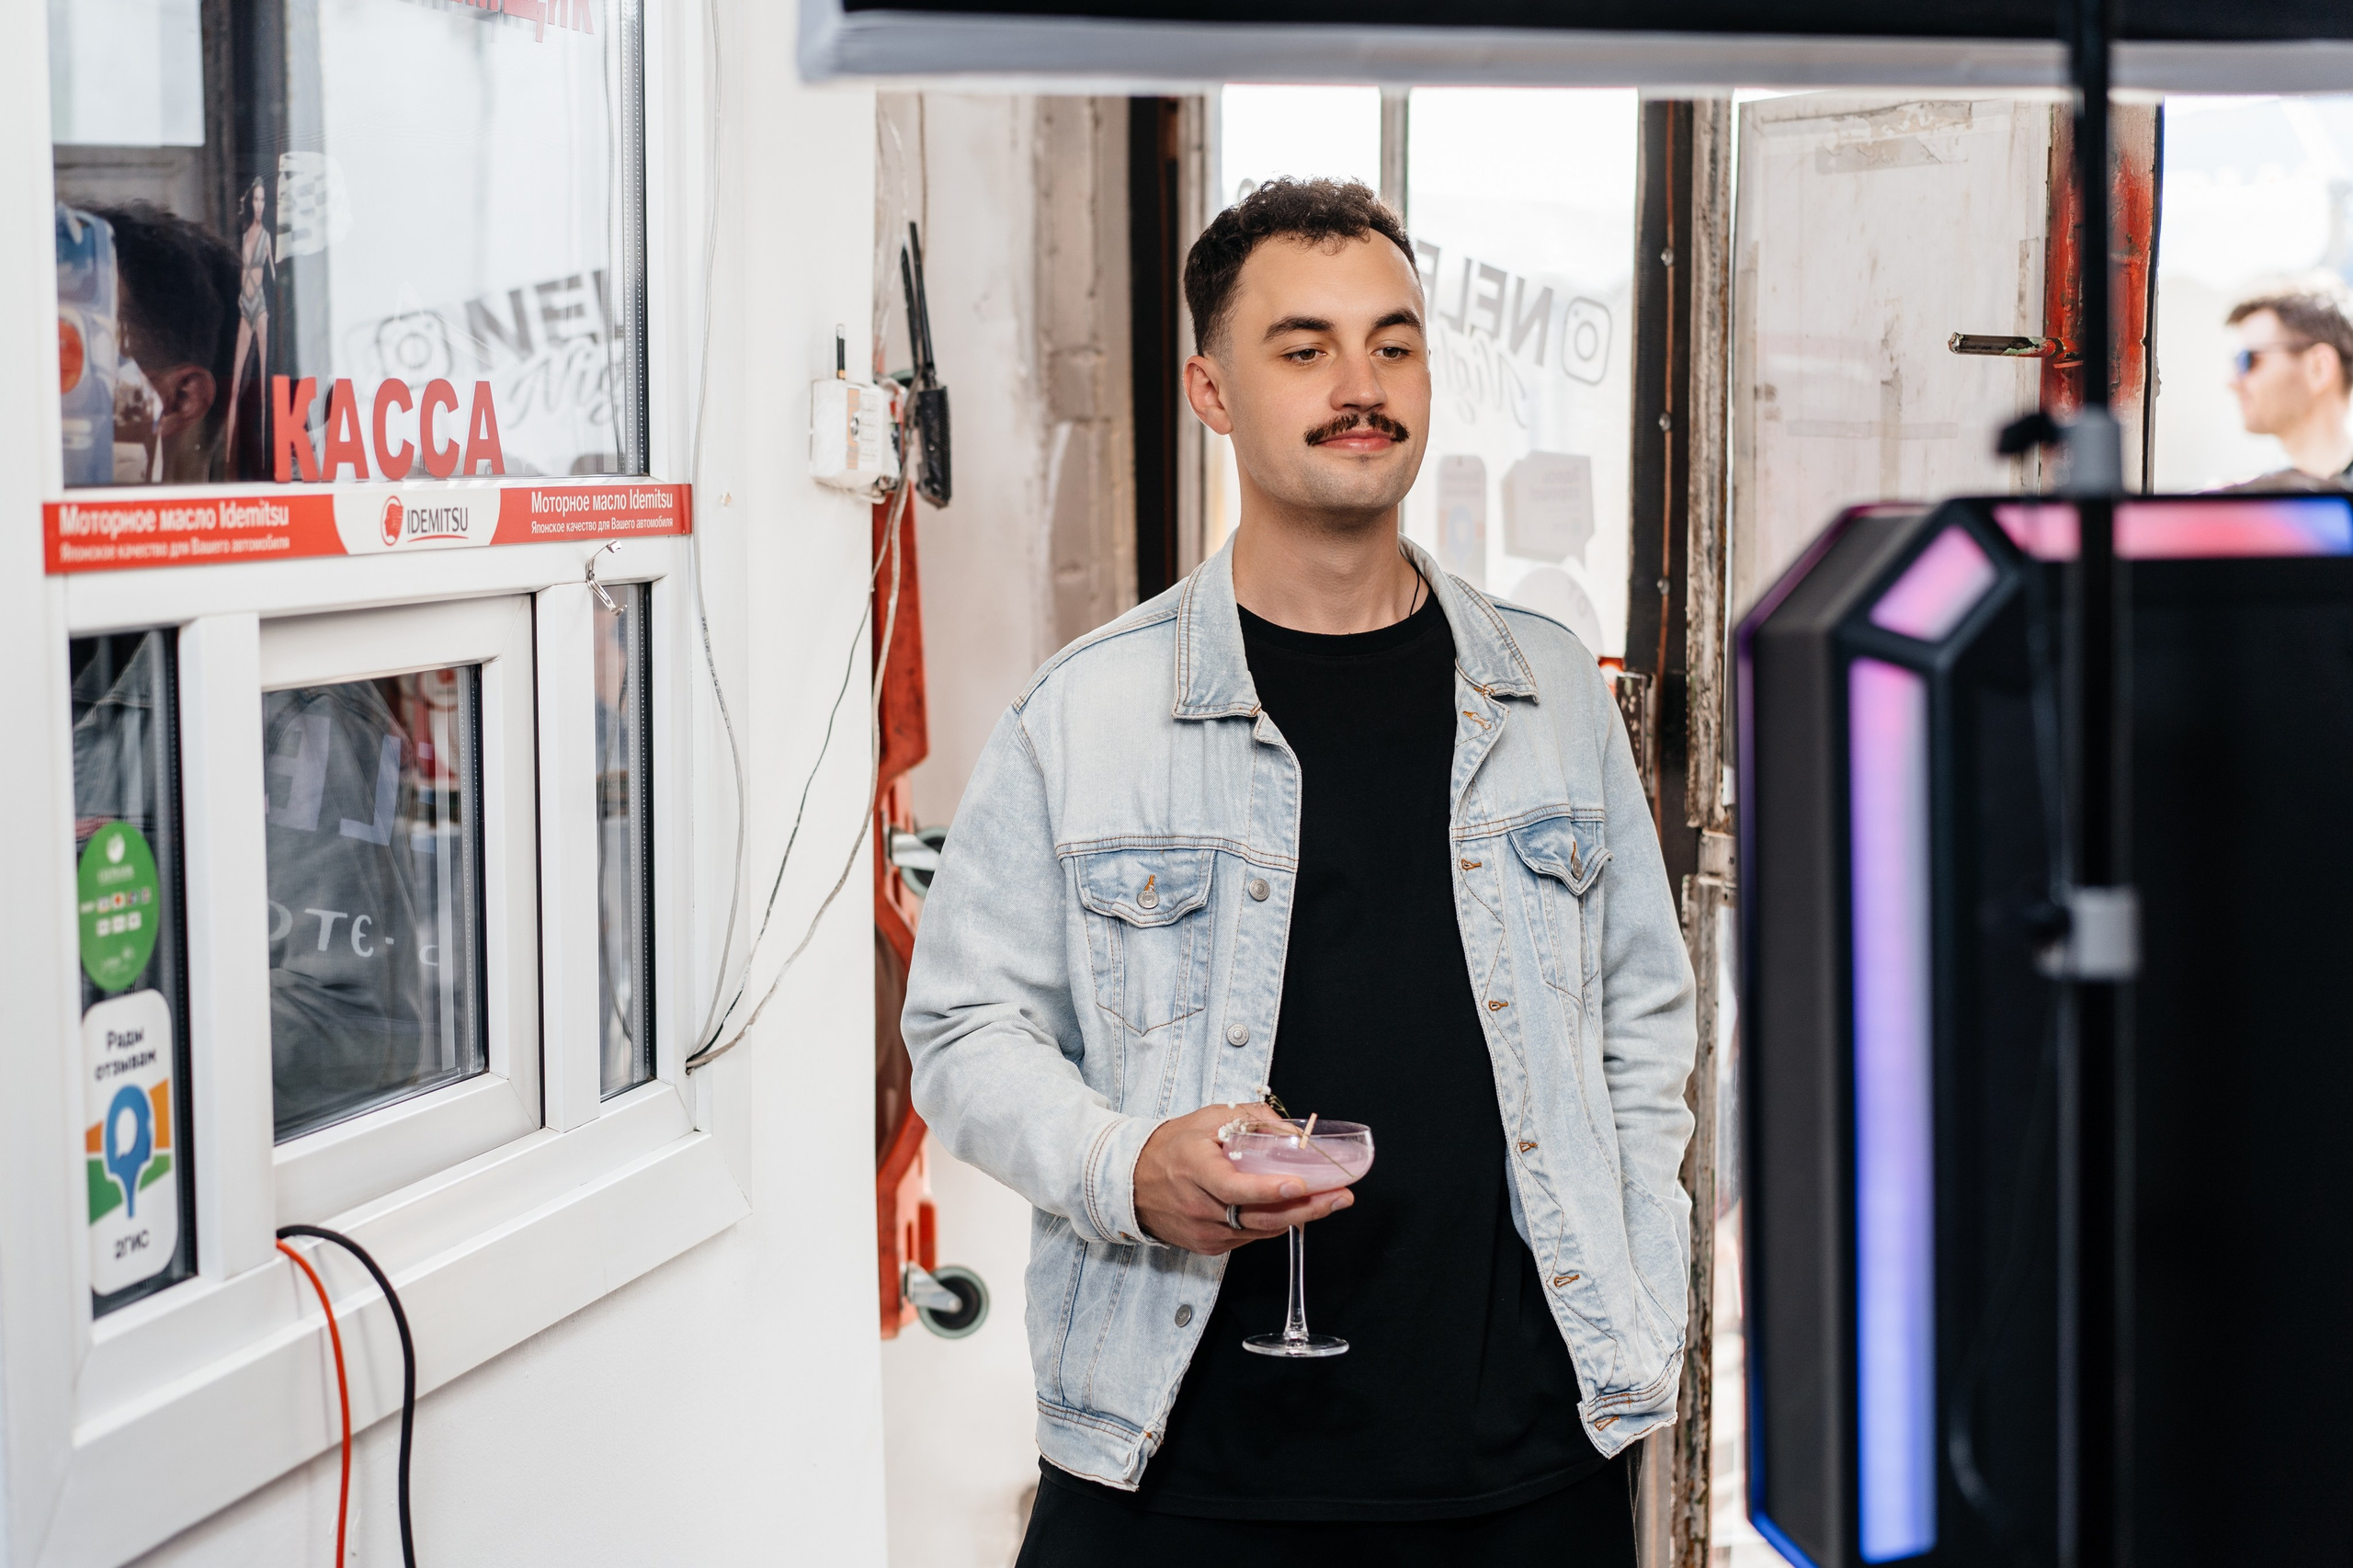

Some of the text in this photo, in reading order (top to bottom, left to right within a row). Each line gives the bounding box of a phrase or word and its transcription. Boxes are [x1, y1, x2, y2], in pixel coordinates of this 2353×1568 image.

[272, 374, 506, 483] КАССА
[531, 488, 673, 517] Моторное масло Idemitsu
[60, 498, 290, 540] Моторное масло Idemitsu
[407, 507, 469, 535] IDEMITSU
[531, 515, 674, 534] Японское качество для Вашего автомобиля
[107, 1028, 143, 1052] Рады
[95, 1050, 156, 1081] отзывам
[115, 1229, 150, 1259] 2ГИС
